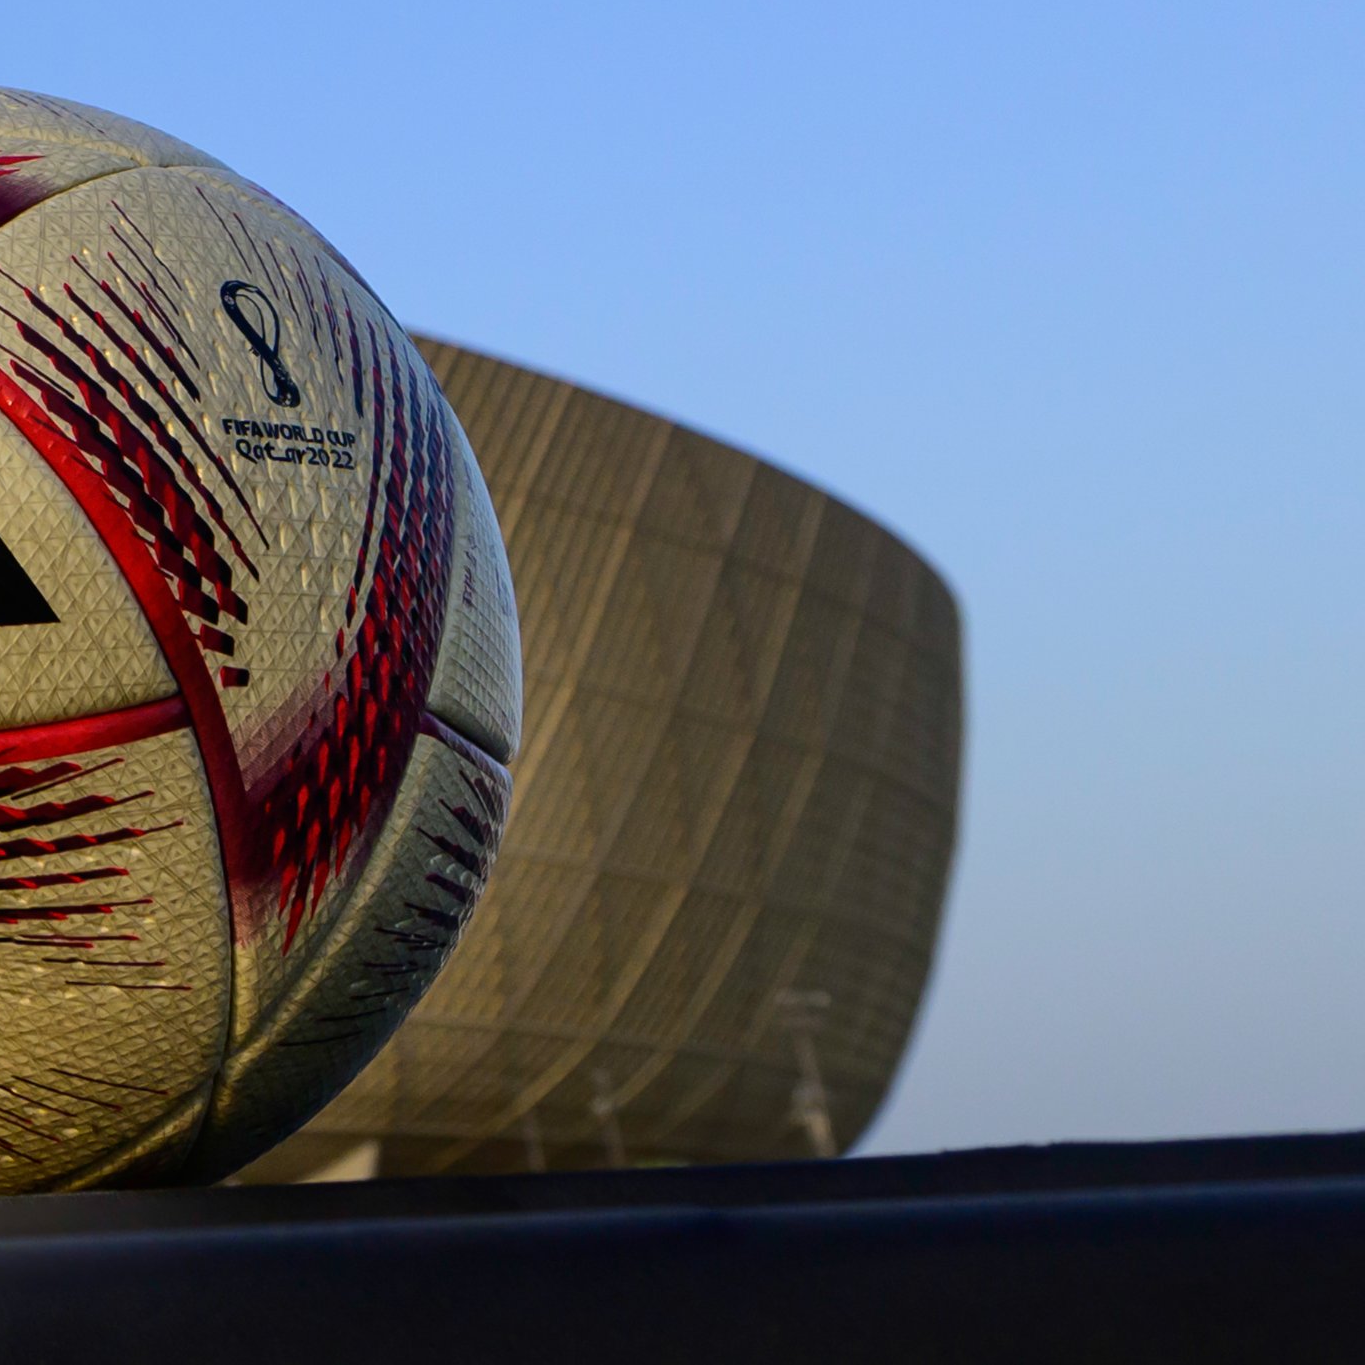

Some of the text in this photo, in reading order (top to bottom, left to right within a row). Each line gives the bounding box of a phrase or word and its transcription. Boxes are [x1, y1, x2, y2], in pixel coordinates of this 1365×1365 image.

[222, 418, 356, 448] FIFA WORLD CUP
